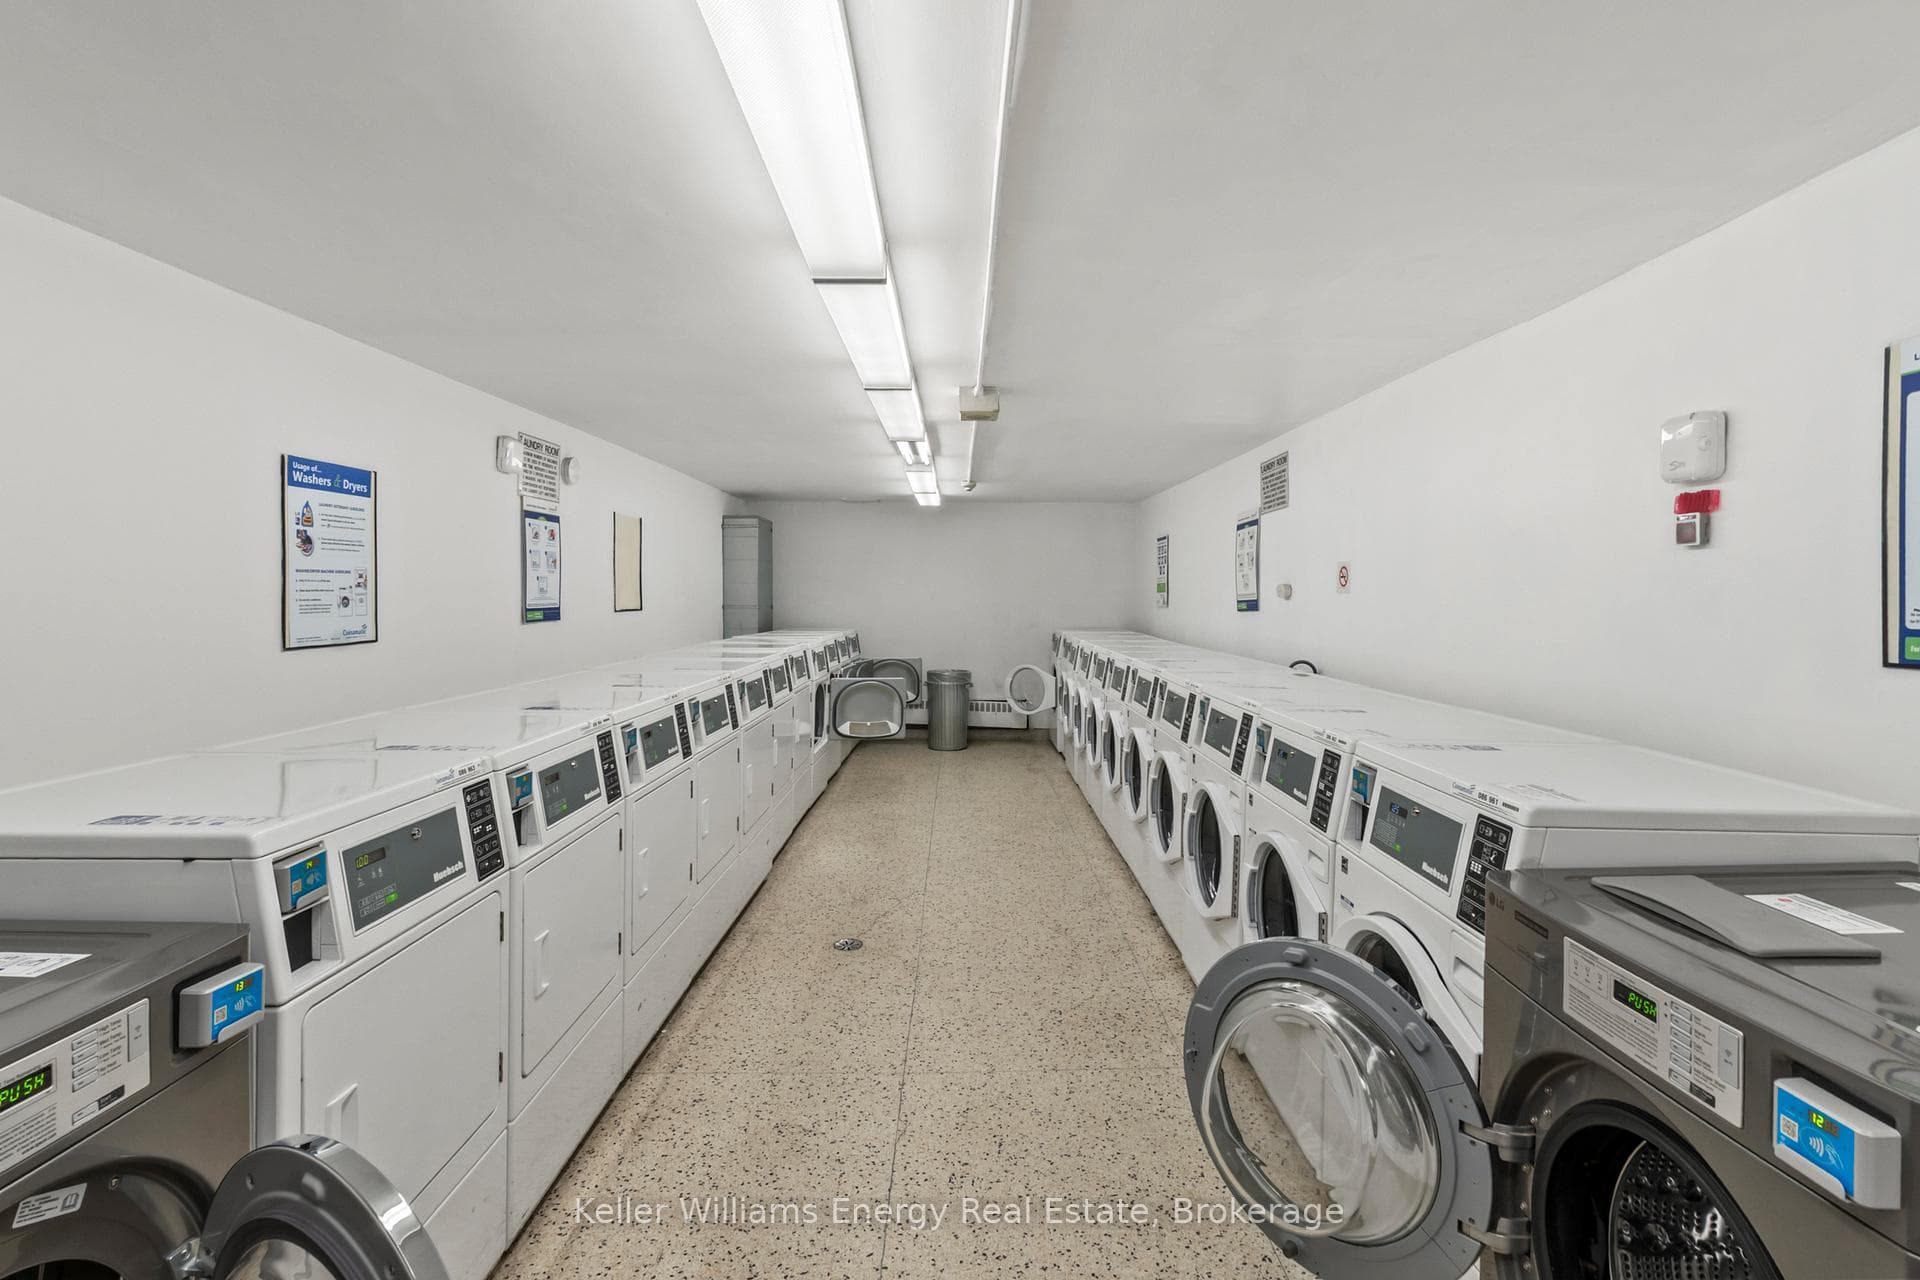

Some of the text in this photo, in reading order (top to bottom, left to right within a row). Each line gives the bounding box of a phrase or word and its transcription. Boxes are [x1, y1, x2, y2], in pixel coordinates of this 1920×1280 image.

[292, 461, 310, 472] Usage
[292, 470, 332, 487] Washers
[343, 479, 368, 493] Dryers
[1496, 897, 1504, 912] LG
[1628, 992, 1657, 1017] PUSH
[0, 1073, 45, 1107] PUSH
[1812, 1112, 1825, 1128] 12
